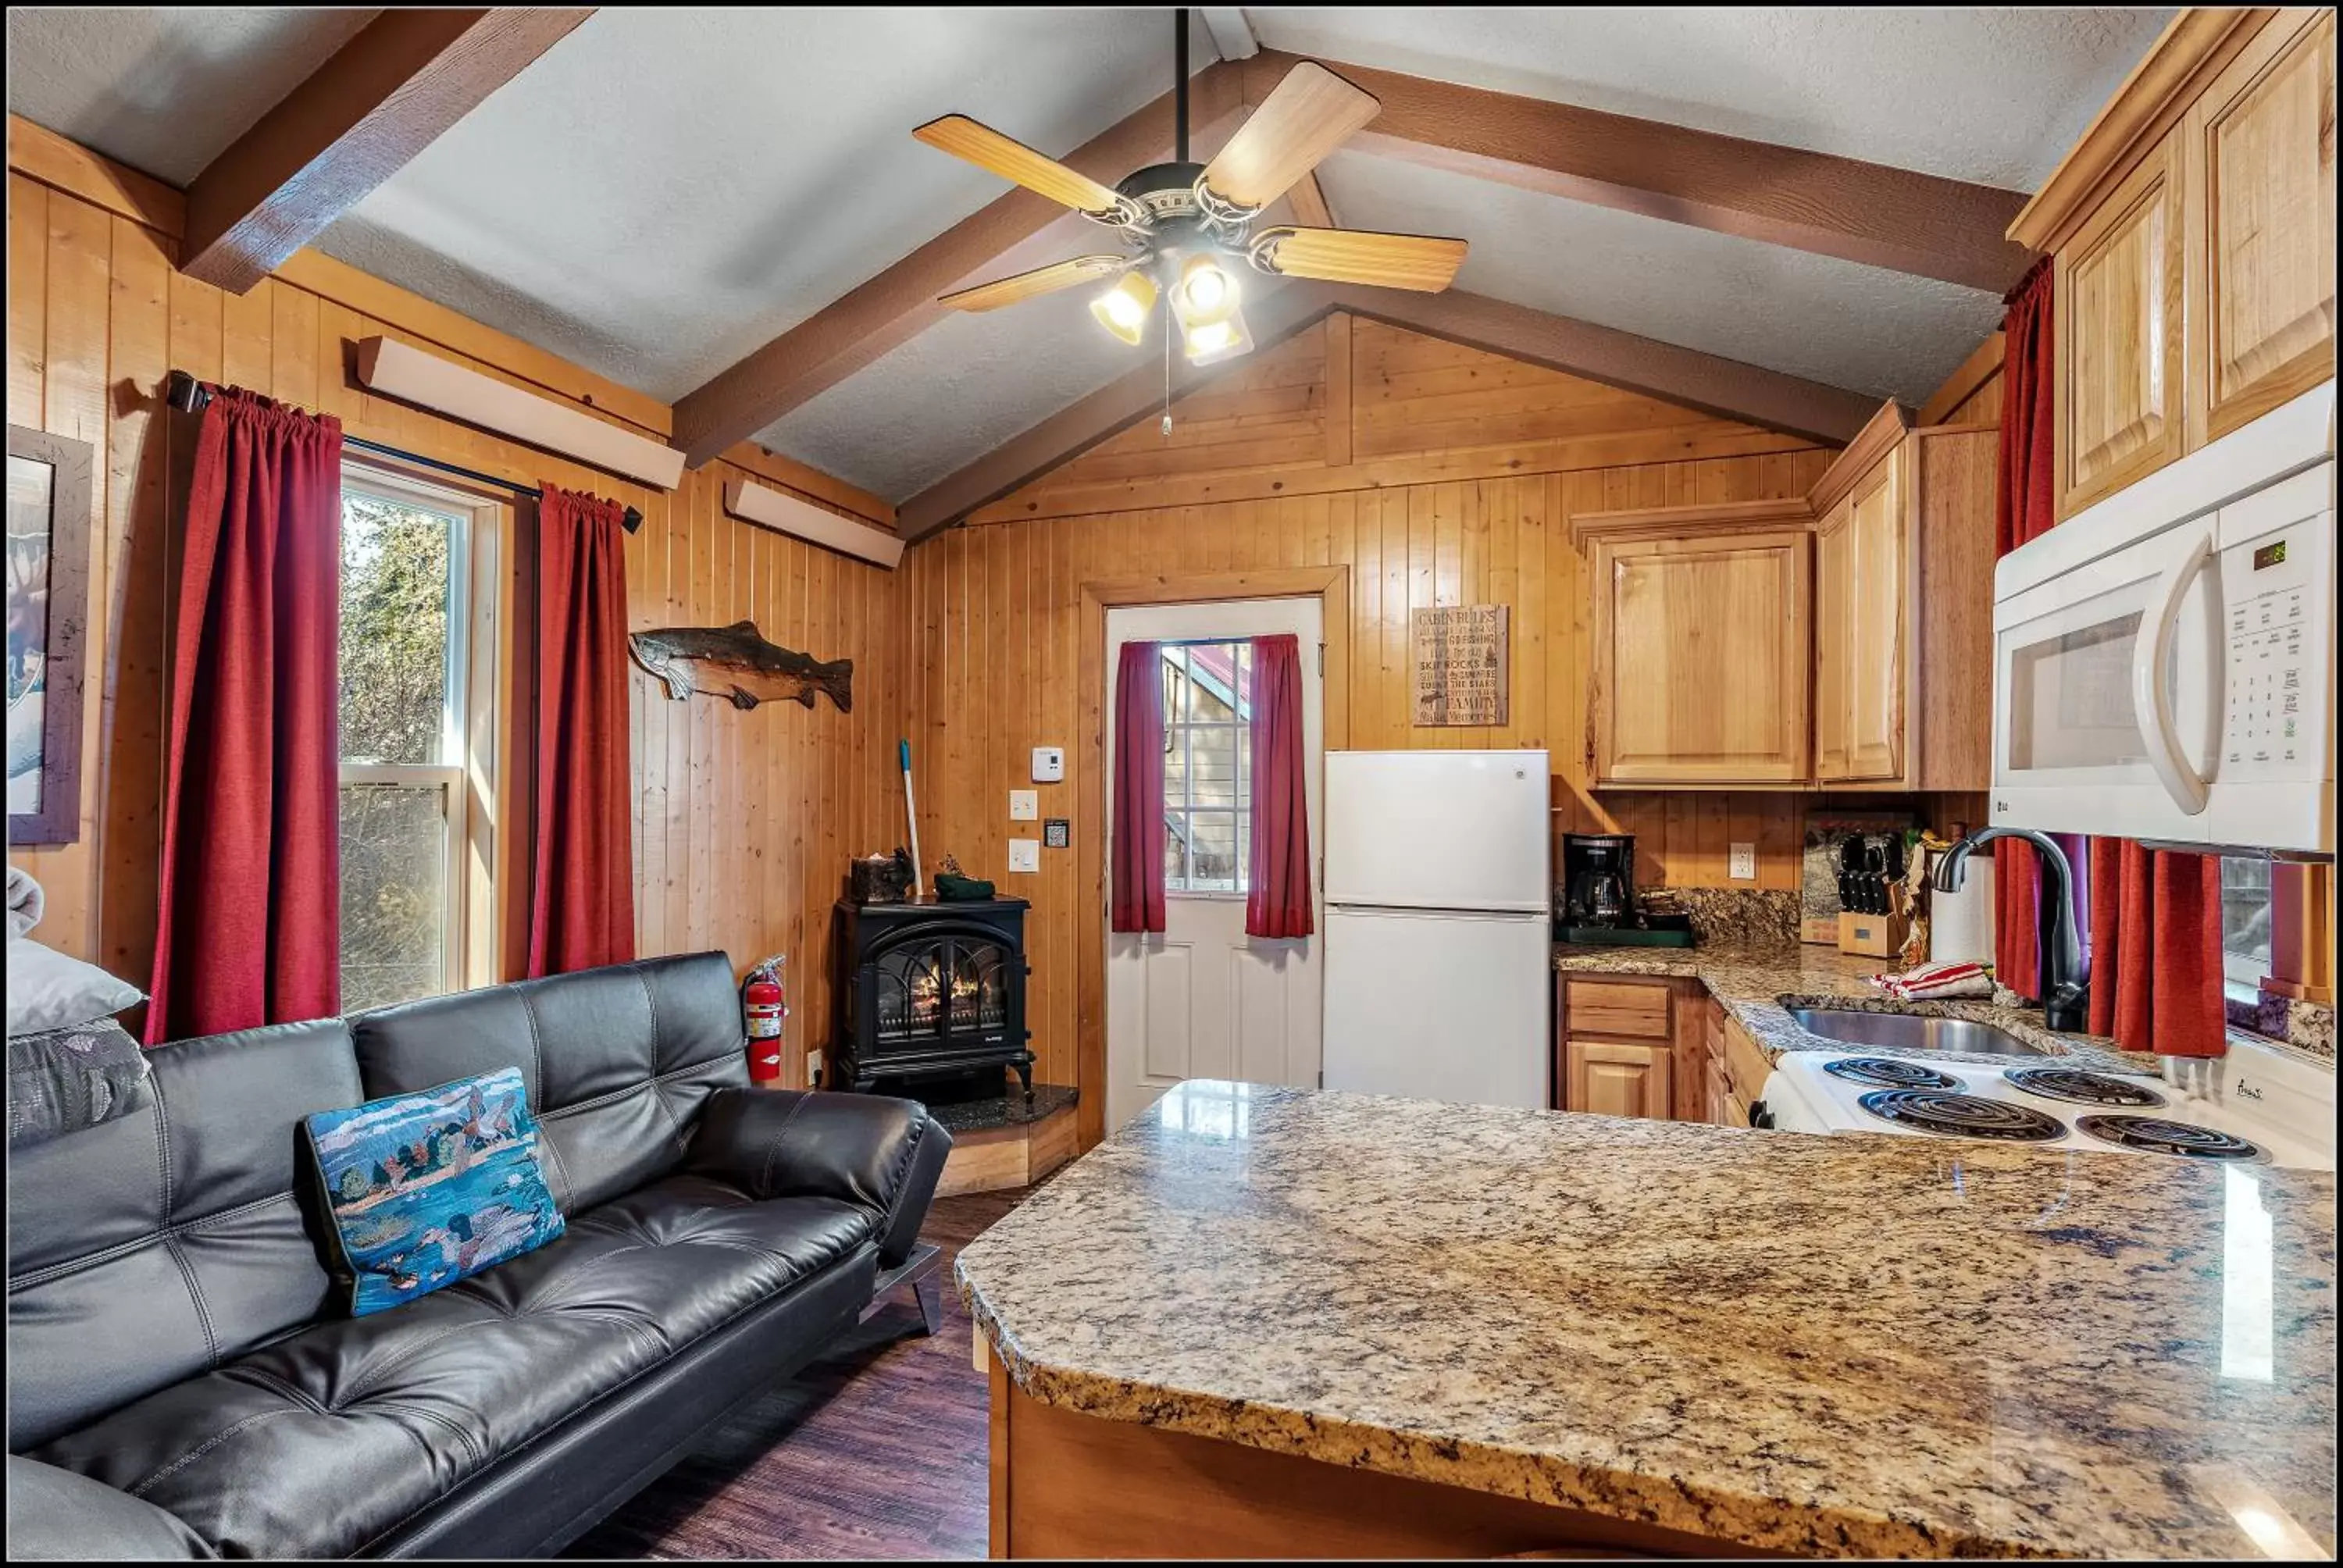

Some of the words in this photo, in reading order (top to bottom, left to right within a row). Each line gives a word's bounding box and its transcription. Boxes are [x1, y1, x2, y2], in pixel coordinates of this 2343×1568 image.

[1419, 613, 1453, 625] CABIN
[1457, 611, 1495, 624] RULES
[1443, 660, 1480, 669] ROCKS
